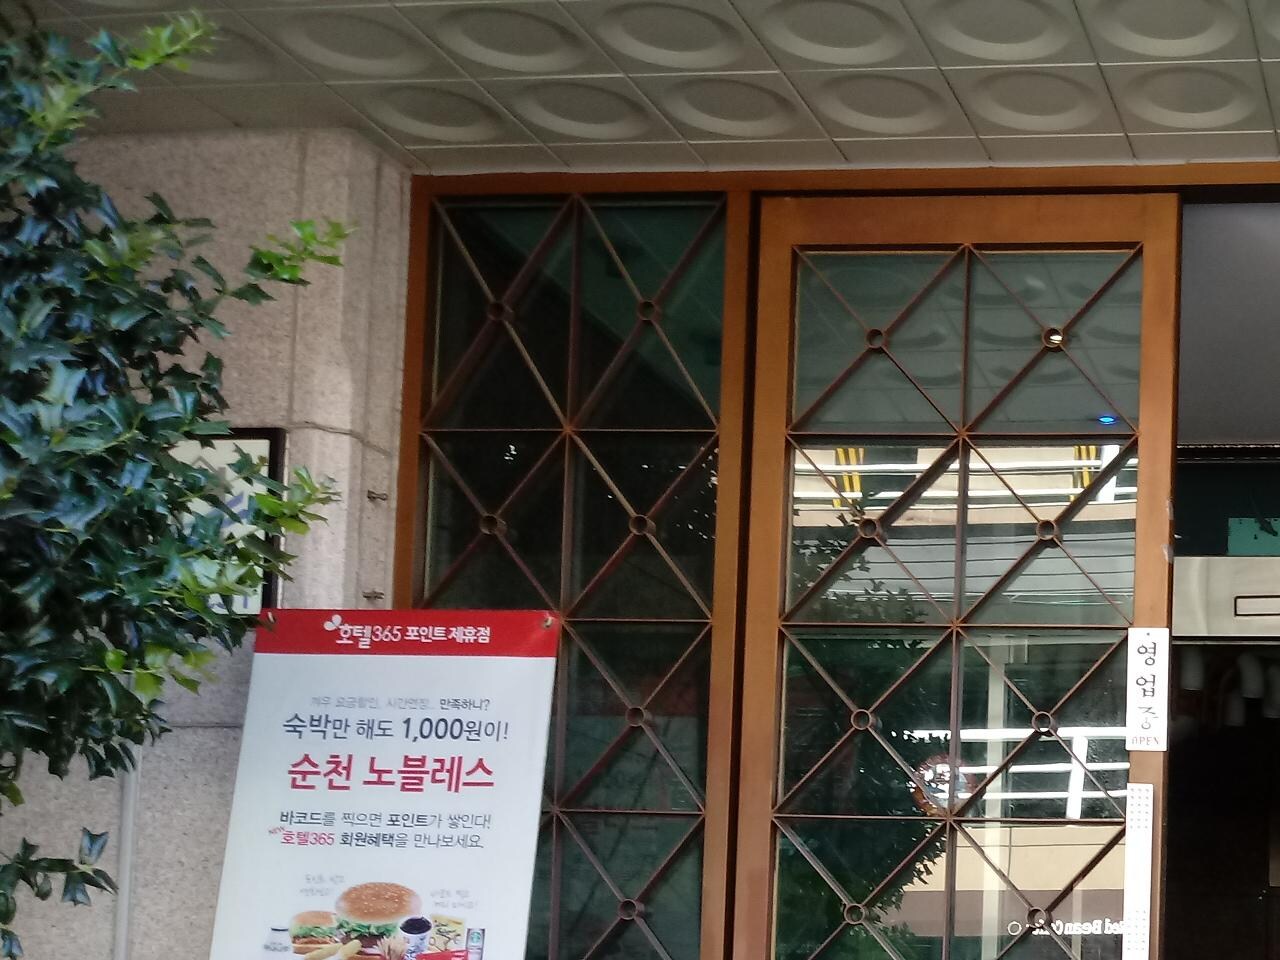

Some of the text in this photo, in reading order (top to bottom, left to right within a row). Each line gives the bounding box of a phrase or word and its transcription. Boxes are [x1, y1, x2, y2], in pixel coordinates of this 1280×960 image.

[335, 624, 491, 648] 호텔365 포인트 제휴점
[1136, 641, 1159, 730] 영업중
[439, 698, 491, 711] 만족하니?
[282, 712, 509, 742] 숙박만 해도 1,000원이!
[1131, 736, 1160, 745] OPEN
[287, 753, 495, 793] 순천 노블레스
[279, 810, 491, 829] 바코드를 찍으면 포인트가 쌓인다!
[280, 831, 335, 846] 호텔365
[340, 832, 409, 848] 회원혜택을
